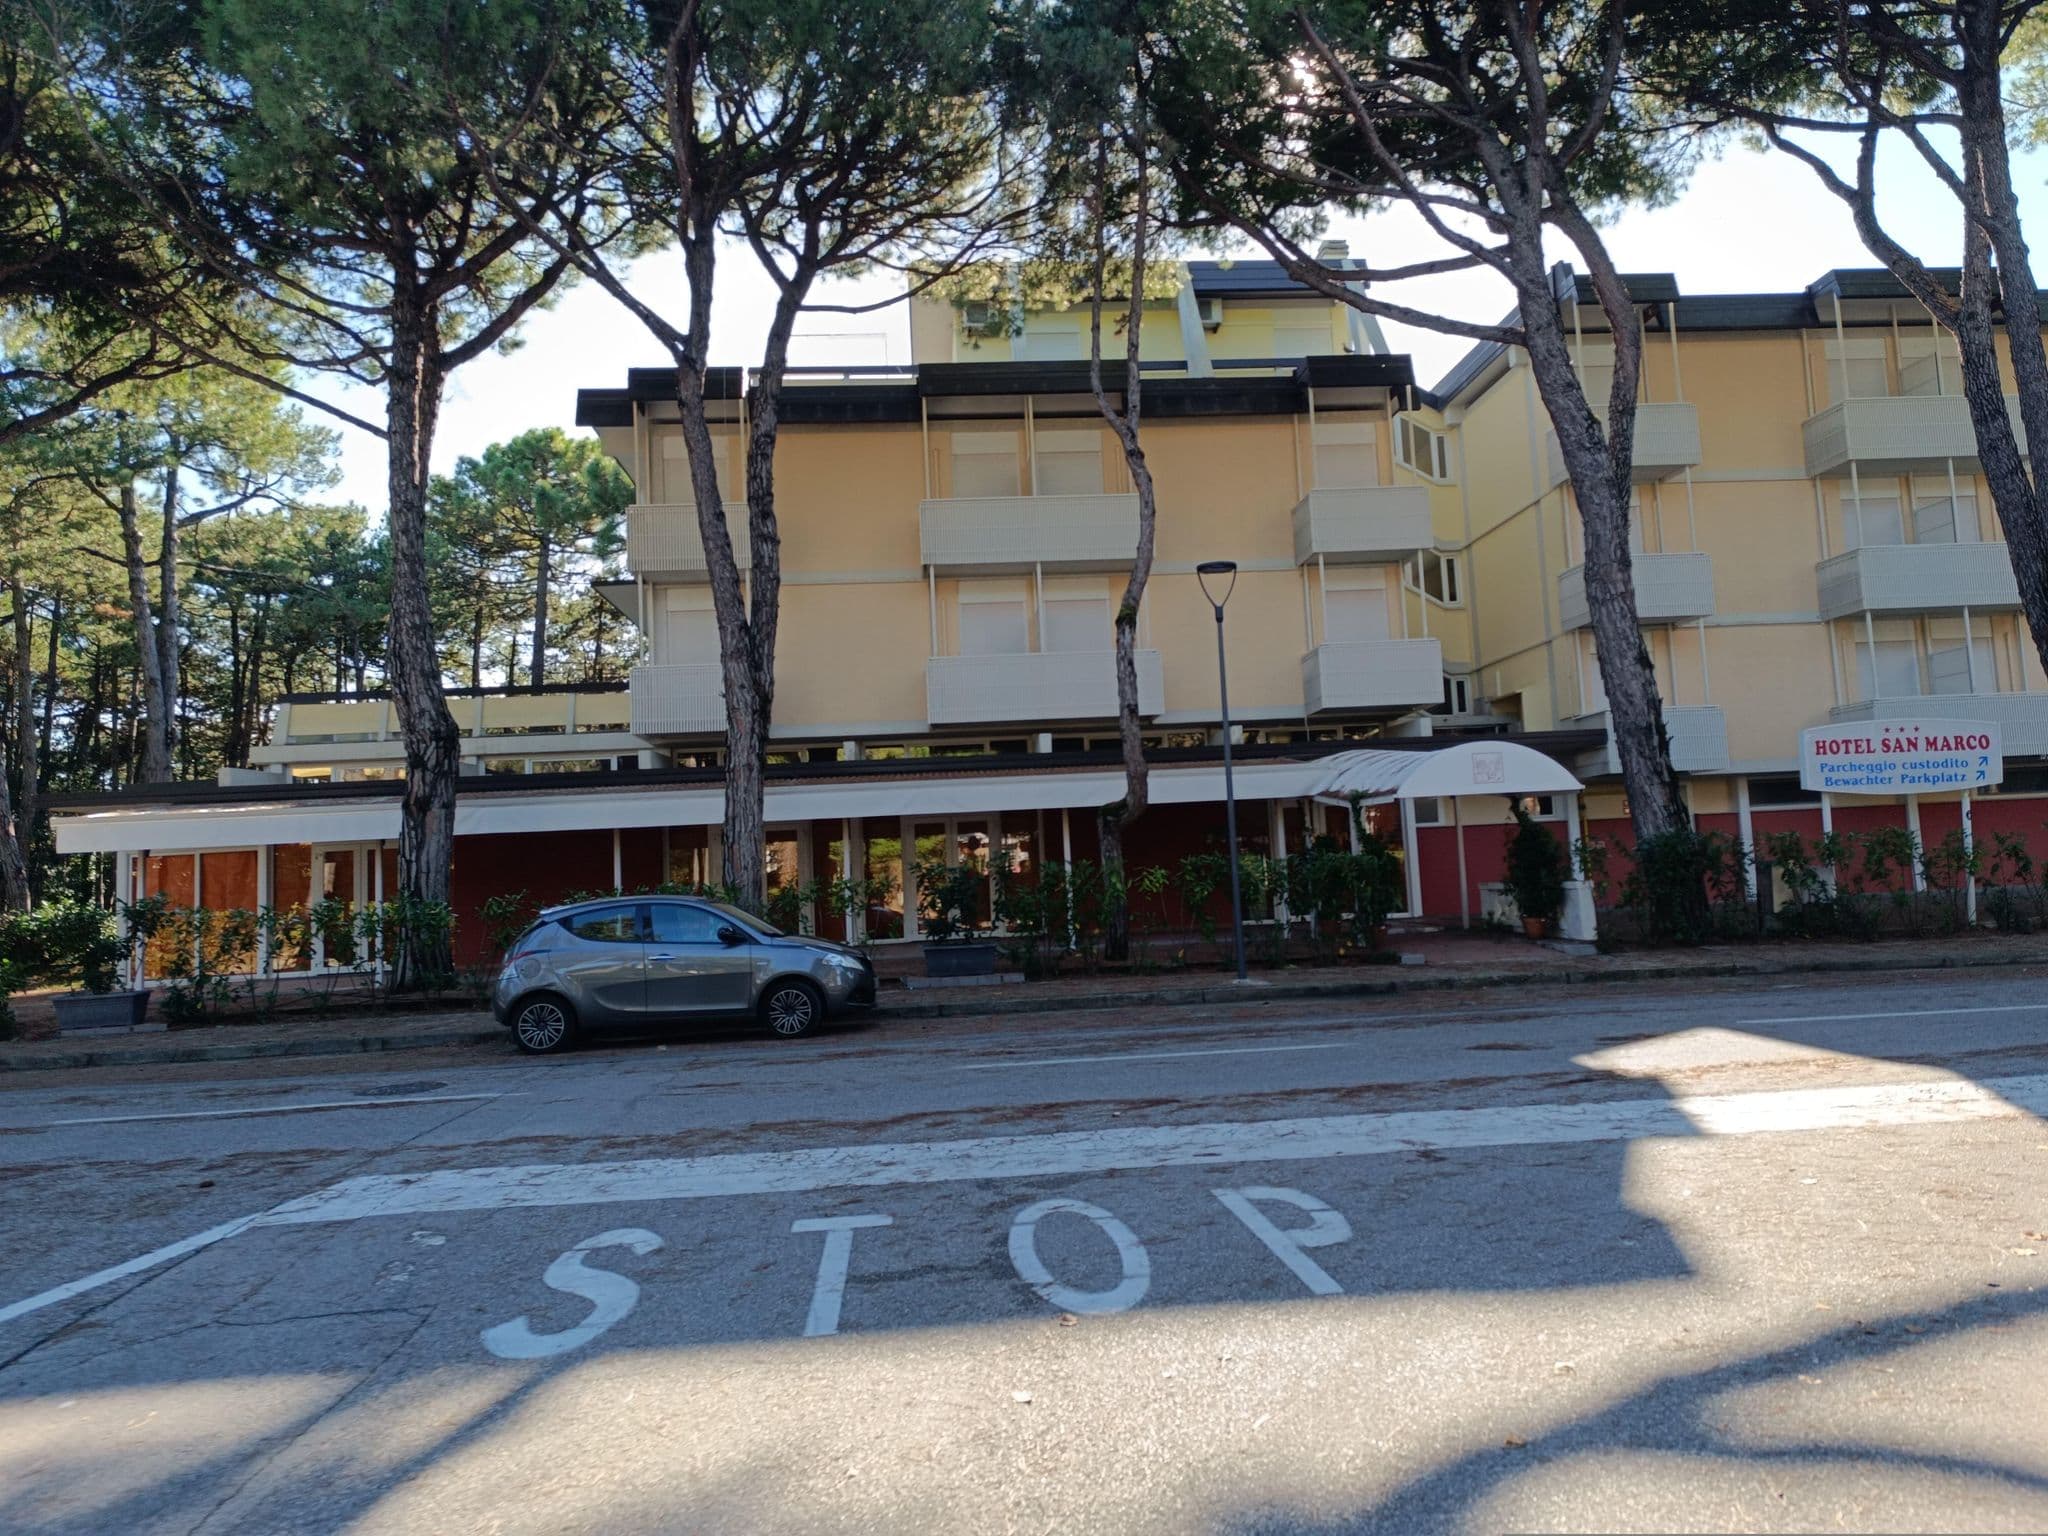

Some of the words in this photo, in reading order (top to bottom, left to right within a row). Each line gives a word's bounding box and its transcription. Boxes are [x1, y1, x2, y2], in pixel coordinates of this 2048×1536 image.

[1815, 738, 1876, 756] HOTEL
[1881, 736, 1920, 753] SAN
[1924, 734, 1991, 751] MARCO
[1819, 761, 1897, 774] Parcheggio
[1901, 758, 1969, 770] custodito
[1824, 775, 1894, 787] Bewachter
[1900, 772, 1968, 785] Parkplatz
[480, 1186, 1354, 1360] STOP
